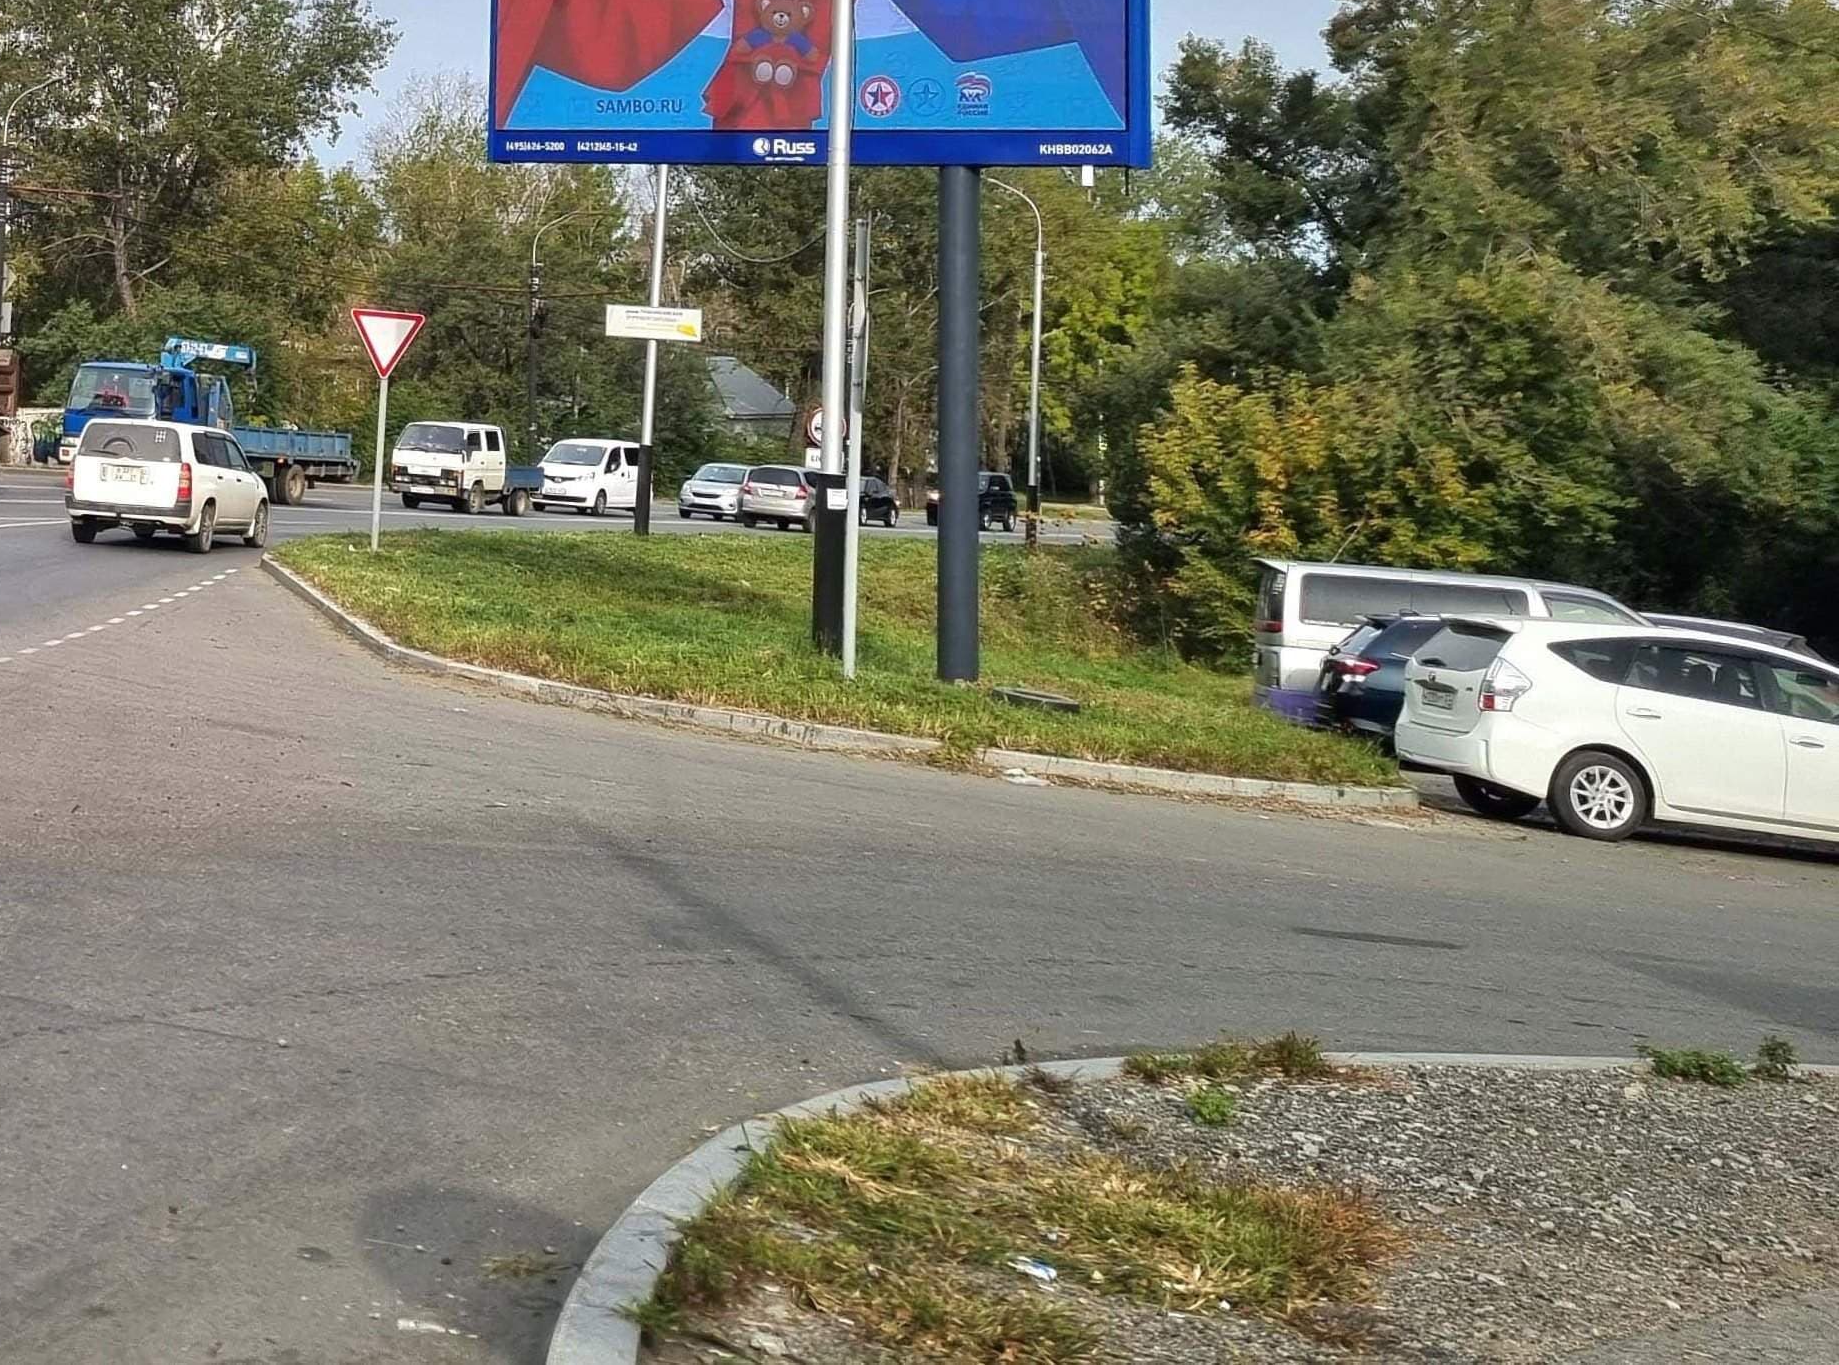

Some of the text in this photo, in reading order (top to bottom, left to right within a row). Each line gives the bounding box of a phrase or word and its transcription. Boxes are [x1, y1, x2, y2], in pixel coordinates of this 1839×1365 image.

[596, 98, 683, 114] SAMBO.RU
[773, 138, 816, 155] Russ
[1039, 144, 1113, 155] KHBB02062A
